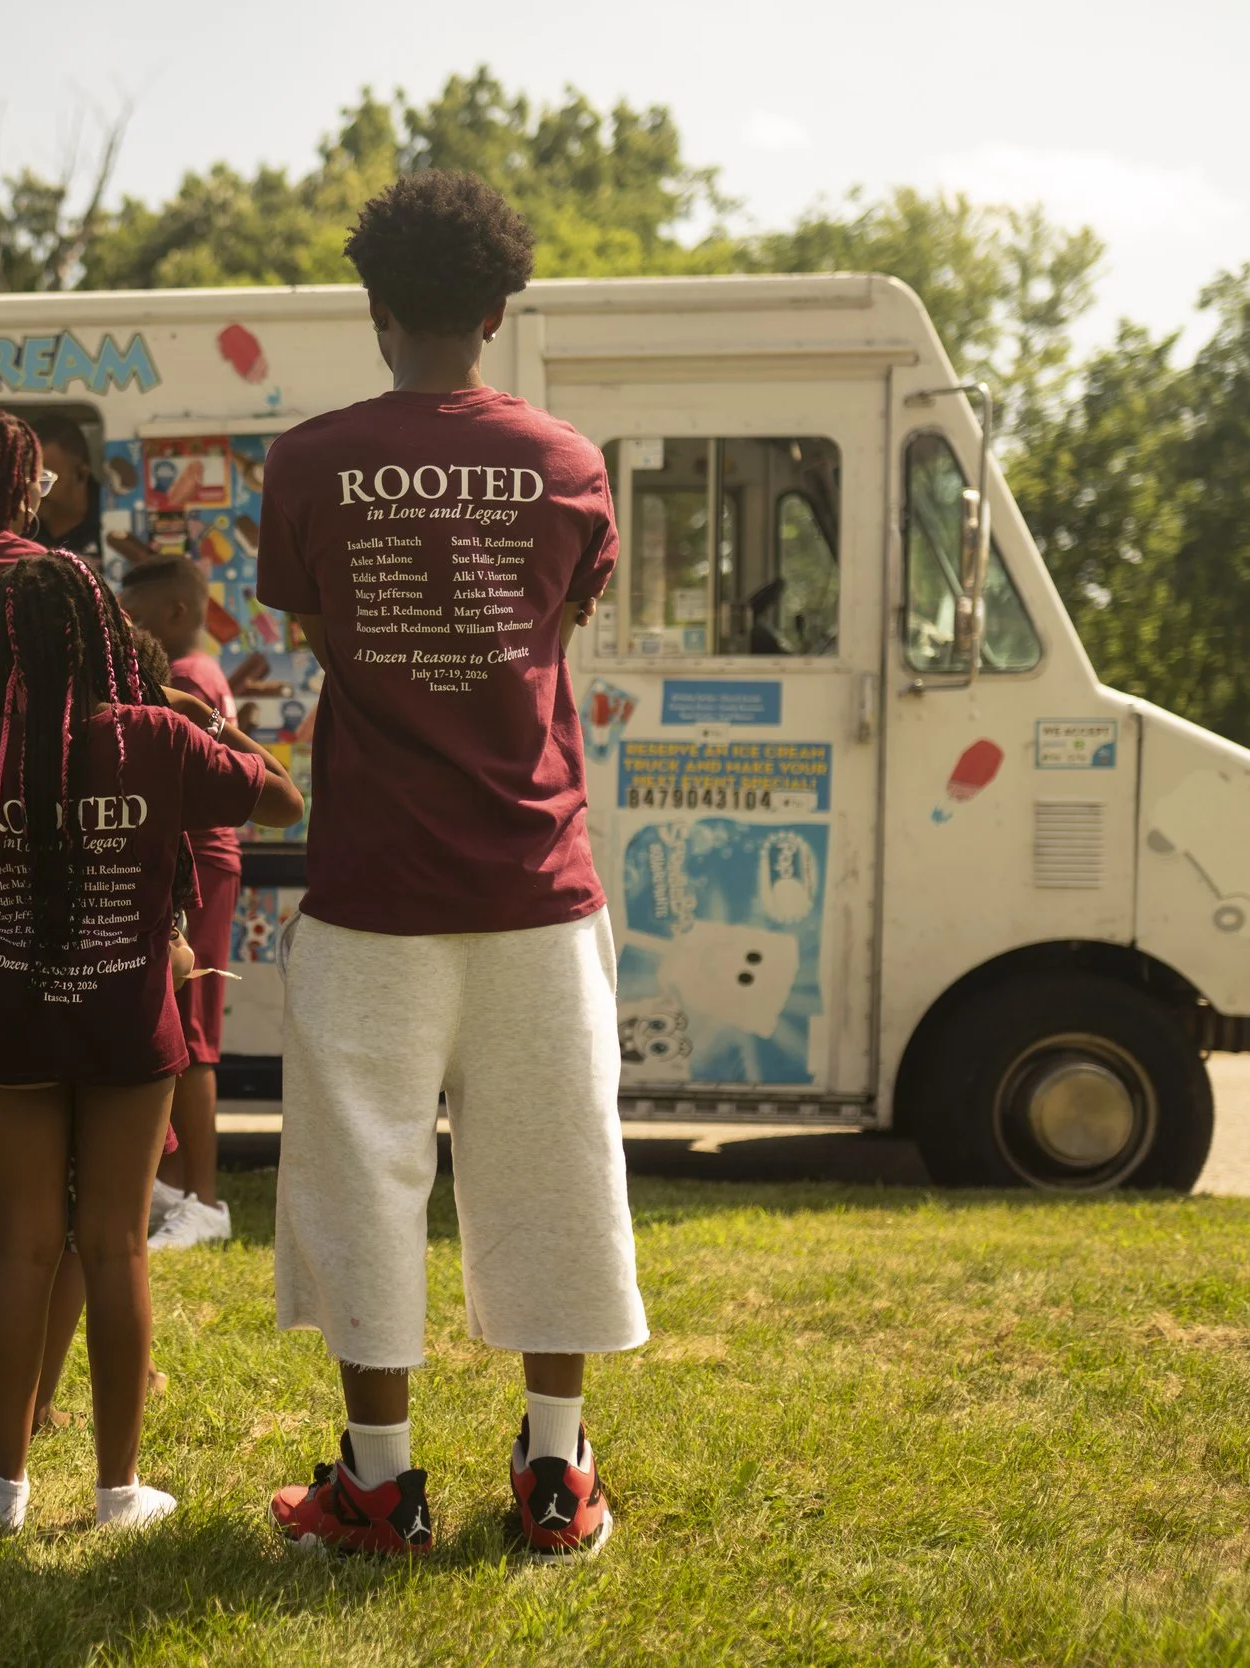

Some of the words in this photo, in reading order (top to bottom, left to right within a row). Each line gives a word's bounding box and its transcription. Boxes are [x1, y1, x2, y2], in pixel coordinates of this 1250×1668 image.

[337, 464, 544, 505] ROOTED
[367, 506, 384, 521] in
[388, 504, 425, 519] Love
[429, 503, 461, 519] and
[465, 504, 518, 526] Legacy
[347, 538, 383, 550] Isabella
[386, 536, 422, 547] Thatch
[451, 536, 471, 546] Sam
[472, 537, 482, 547] H.
[484, 537, 533, 548] Redmond
[350, 556, 374, 567] Aslee
[376, 554, 413, 565] Malone
[452, 554, 470, 564] Sue
[472, 553, 495, 564] Hallie
[495, 554, 525, 566] James
[352, 573, 376, 583] Eddie
[379, 571, 428, 582] Redmond
[453, 571, 475, 581] Alki
[477, 570, 487, 580] V.
[488, 571, 517, 581] Horton
[377, 588, 423, 602] Jefferson
[453, 588, 486, 599] Ariska
[488, 587, 524, 597] Redmond
[356, 605, 378, 616] James
[381, 606, 390, 616] E.
[392, 605, 442, 616] Redmond
[454, 606, 481, 619] Mary
[483, 604, 514, 615] Gibson
[356, 622, 398, 633] Roosevelt
[401, 623, 450, 633] Redmond
[454, 624, 495, 634] William
[497, 619, 534, 632] Redmond
[353, 649, 363, 661] A
[365, 650, 407, 663] Dozen
[412, 650, 466, 664] Reasons
[470, 653, 483, 665] to
[487, 646, 530, 664] Celebrate
[411, 669, 431, 681] July
[434, 669, 463, 680] 17-19,
[466, 670, 488, 680] 2026
[429, 682, 458, 692] Itasca,
[461, 682, 471, 691] IL
[626, 743, 698, 757] RESERVE
[733, 745, 760, 758] ICE
[765, 746, 826, 760] CREAM
[624, 758, 679, 773] TRUCK
[686, 759, 722, 773] AND
[725, 760, 774, 774] MAKE
[780, 761, 828, 775] YOUR
[632, 774, 676, 788] NEXT
[681, 774, 736, 789] EVENT
[628, 789, 771, 810] 8479043104
[83, 836, 127, 854] Legacy
[84, 881, 109, 892] Hallie
[110, 881, 136, 893] James
[100, 898, 132, 908] Horton
[97, 911, 140, 925] Redmond
[74, 939, 103, 950] illiam
[82, 965, 94, 976] to
[96, 954, 147, 975] Celebrate
[51, 981, 75, 992] 7-19,
[77, 981, 98, 991] 2026
[44, 992, 70, 1005] Itasca,
[72, 994, 83, 1003] IL
